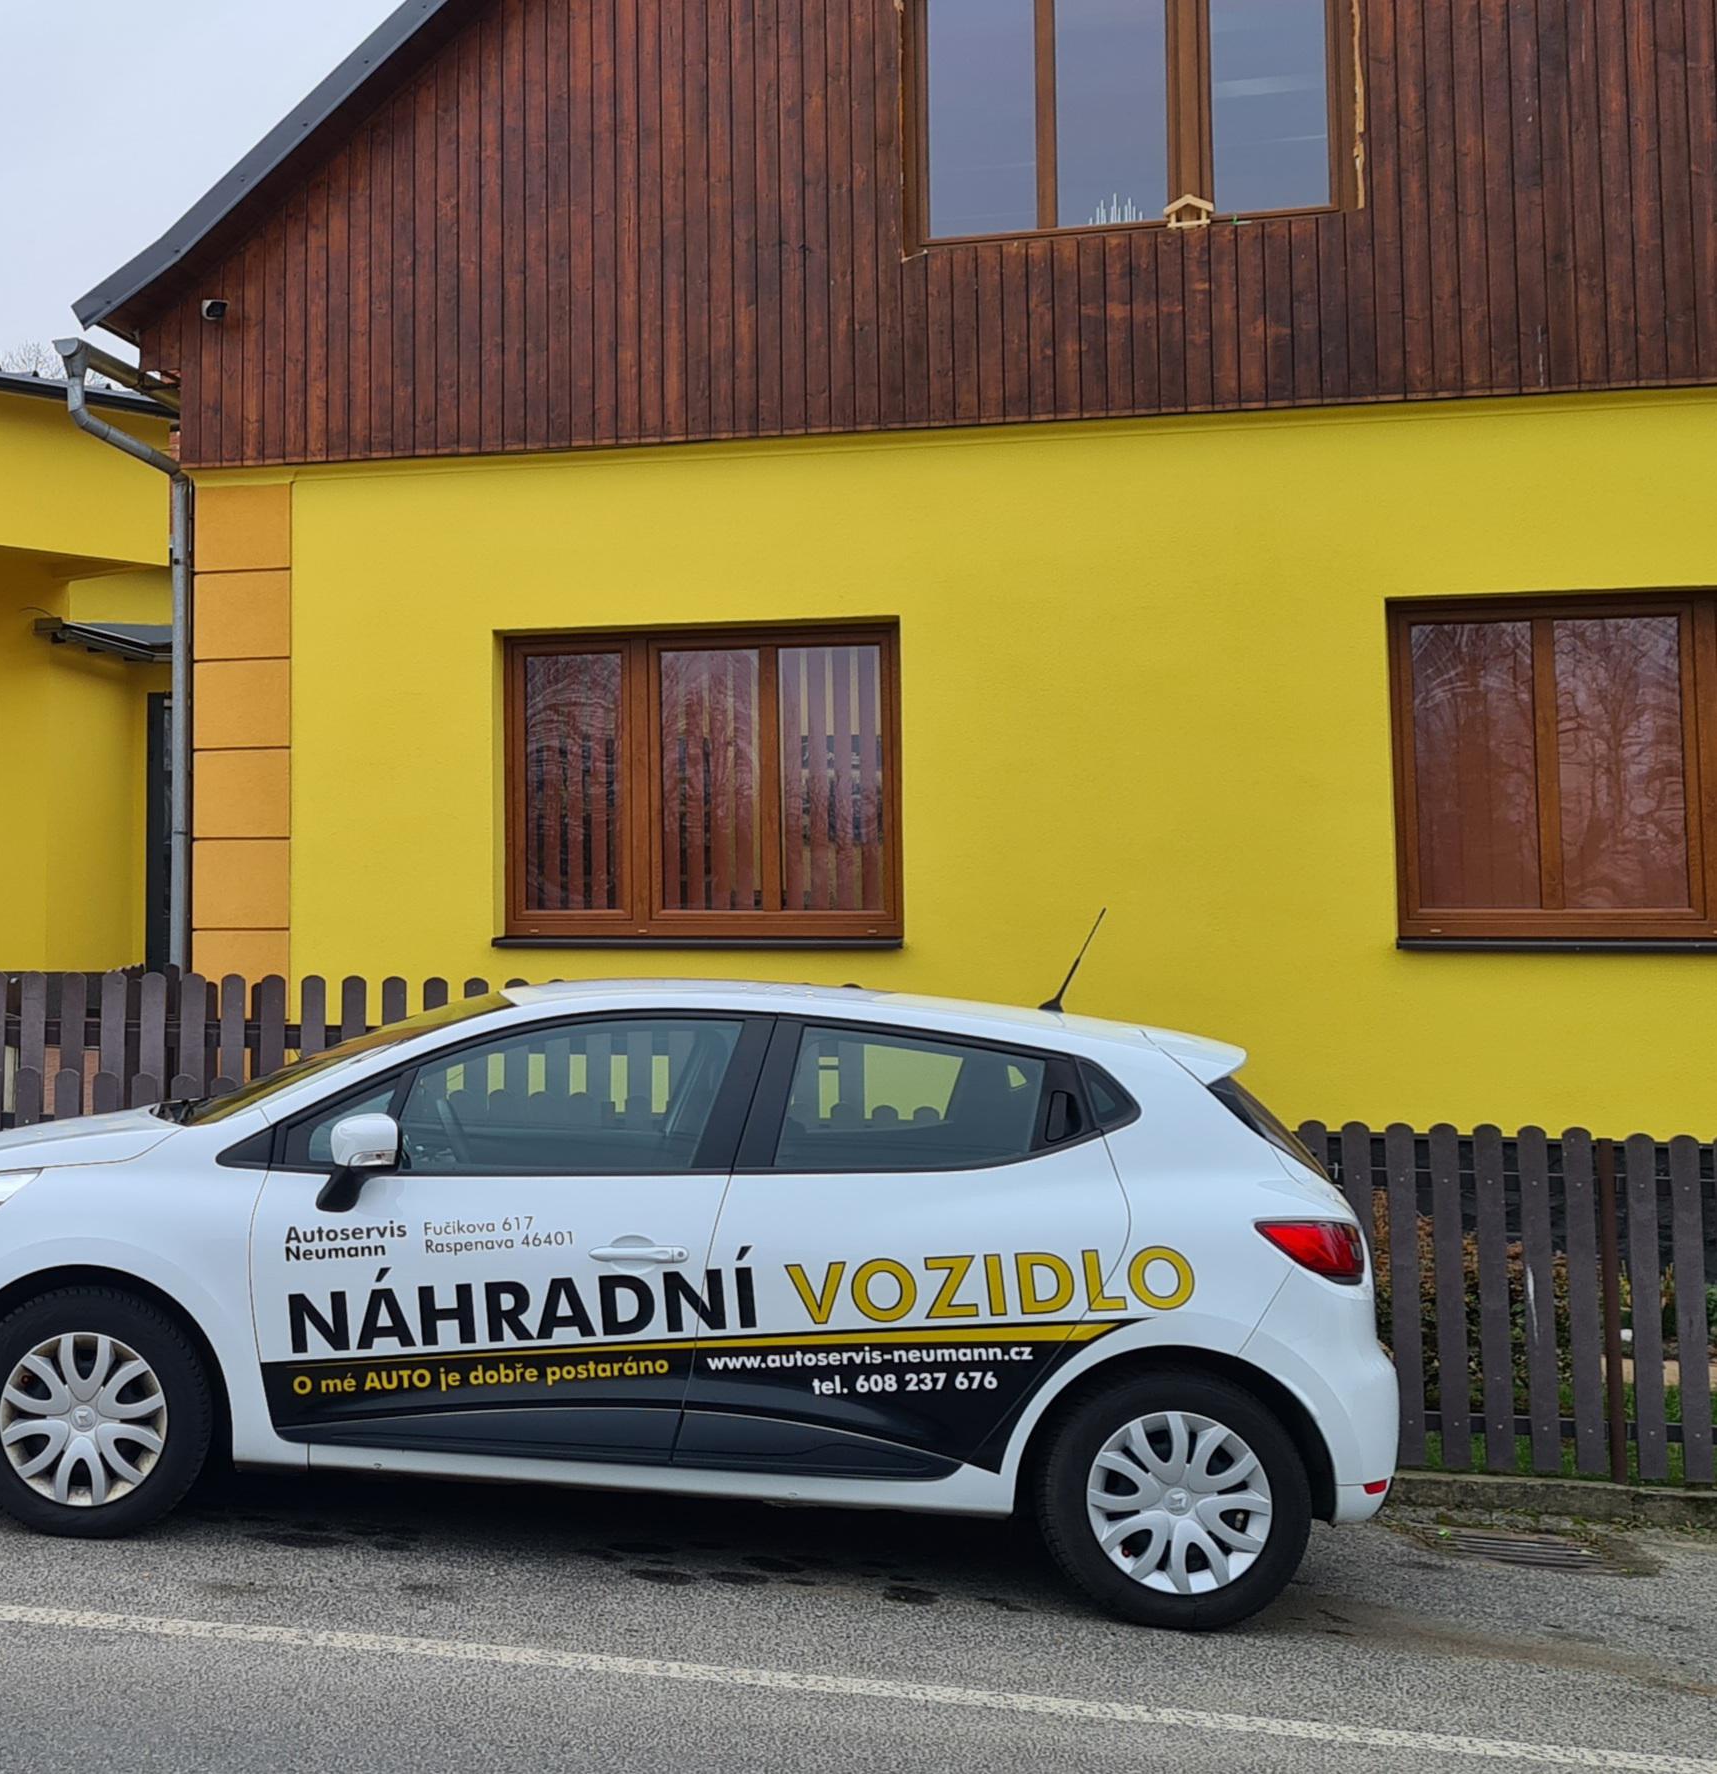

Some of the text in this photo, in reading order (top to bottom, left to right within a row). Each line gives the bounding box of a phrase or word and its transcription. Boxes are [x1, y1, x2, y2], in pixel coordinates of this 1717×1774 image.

[285, 1220, 407, 1244] Autoservis
[502, 1216, 533, 1232] 617
[285, 1243, 386, 1262] Neumann
[424, 1231, 574, 1256] Raspenava 46401
[288, 1245, 1195, 1354] NÁHRADNÍ VOZIDLO
[706, 1344, 1033, 1370] www.autoservis-neumann.cz
[293, 1356, 669, 1394] O mé AUTO je dobře postaráno
[812, 1371, 998, 1396] tel. 608 237 676
